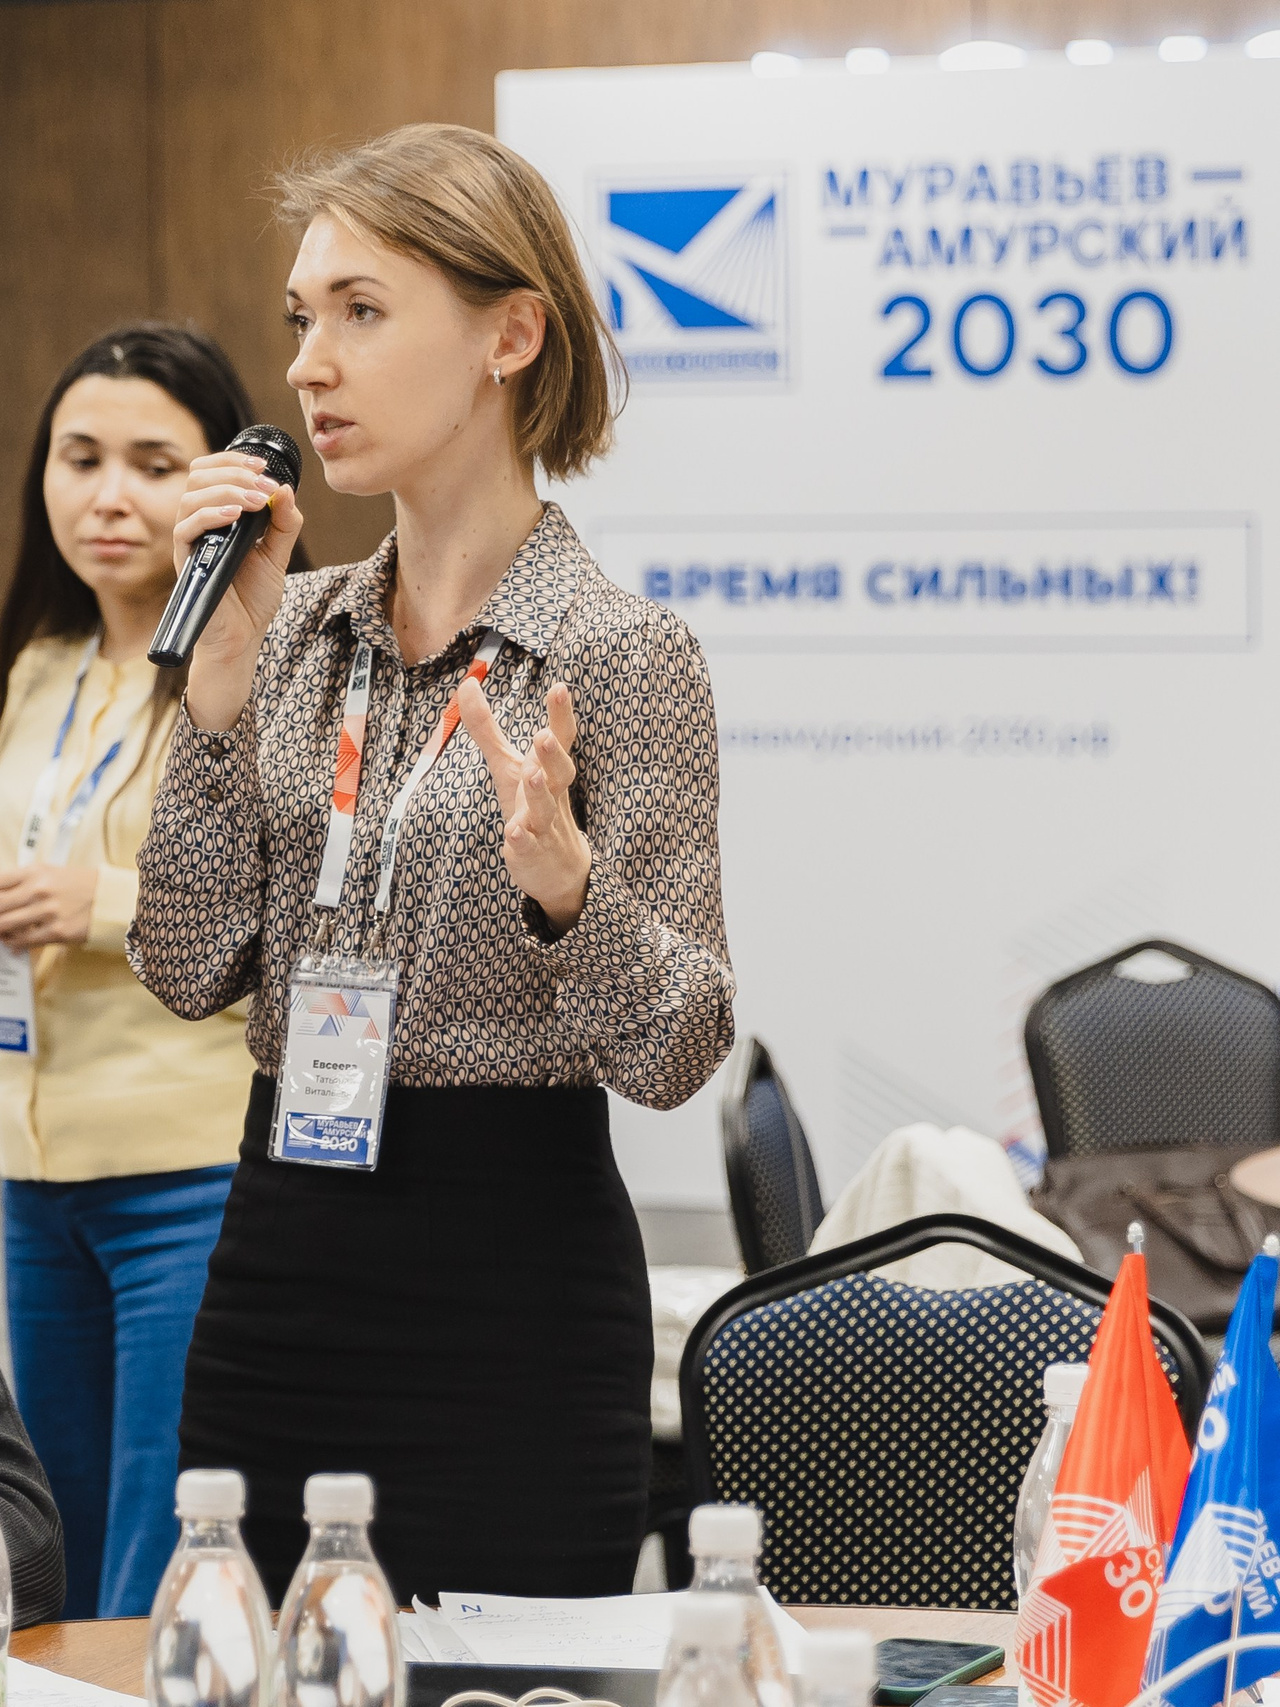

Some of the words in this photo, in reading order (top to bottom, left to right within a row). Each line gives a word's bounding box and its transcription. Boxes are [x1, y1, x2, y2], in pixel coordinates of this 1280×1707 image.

[820, 156, 1167, 207] МУРАВЬЕВ
[878, 196, 1249, 268] АМУРСКИЙ
[877, 291, 1176, 379] 2030
[642, 561, 842, 603] ВРЕМЯ
[863, 557, 1200, 604] СИЛЬНЫХ!
[304, 1086, 357, 1100] Виталь
[315, 1074, 354, 1086] Тать
[317, 1120, 359, 1130] МУРАВЬЕВ
[321, 1136, 358, 1152] 2030
